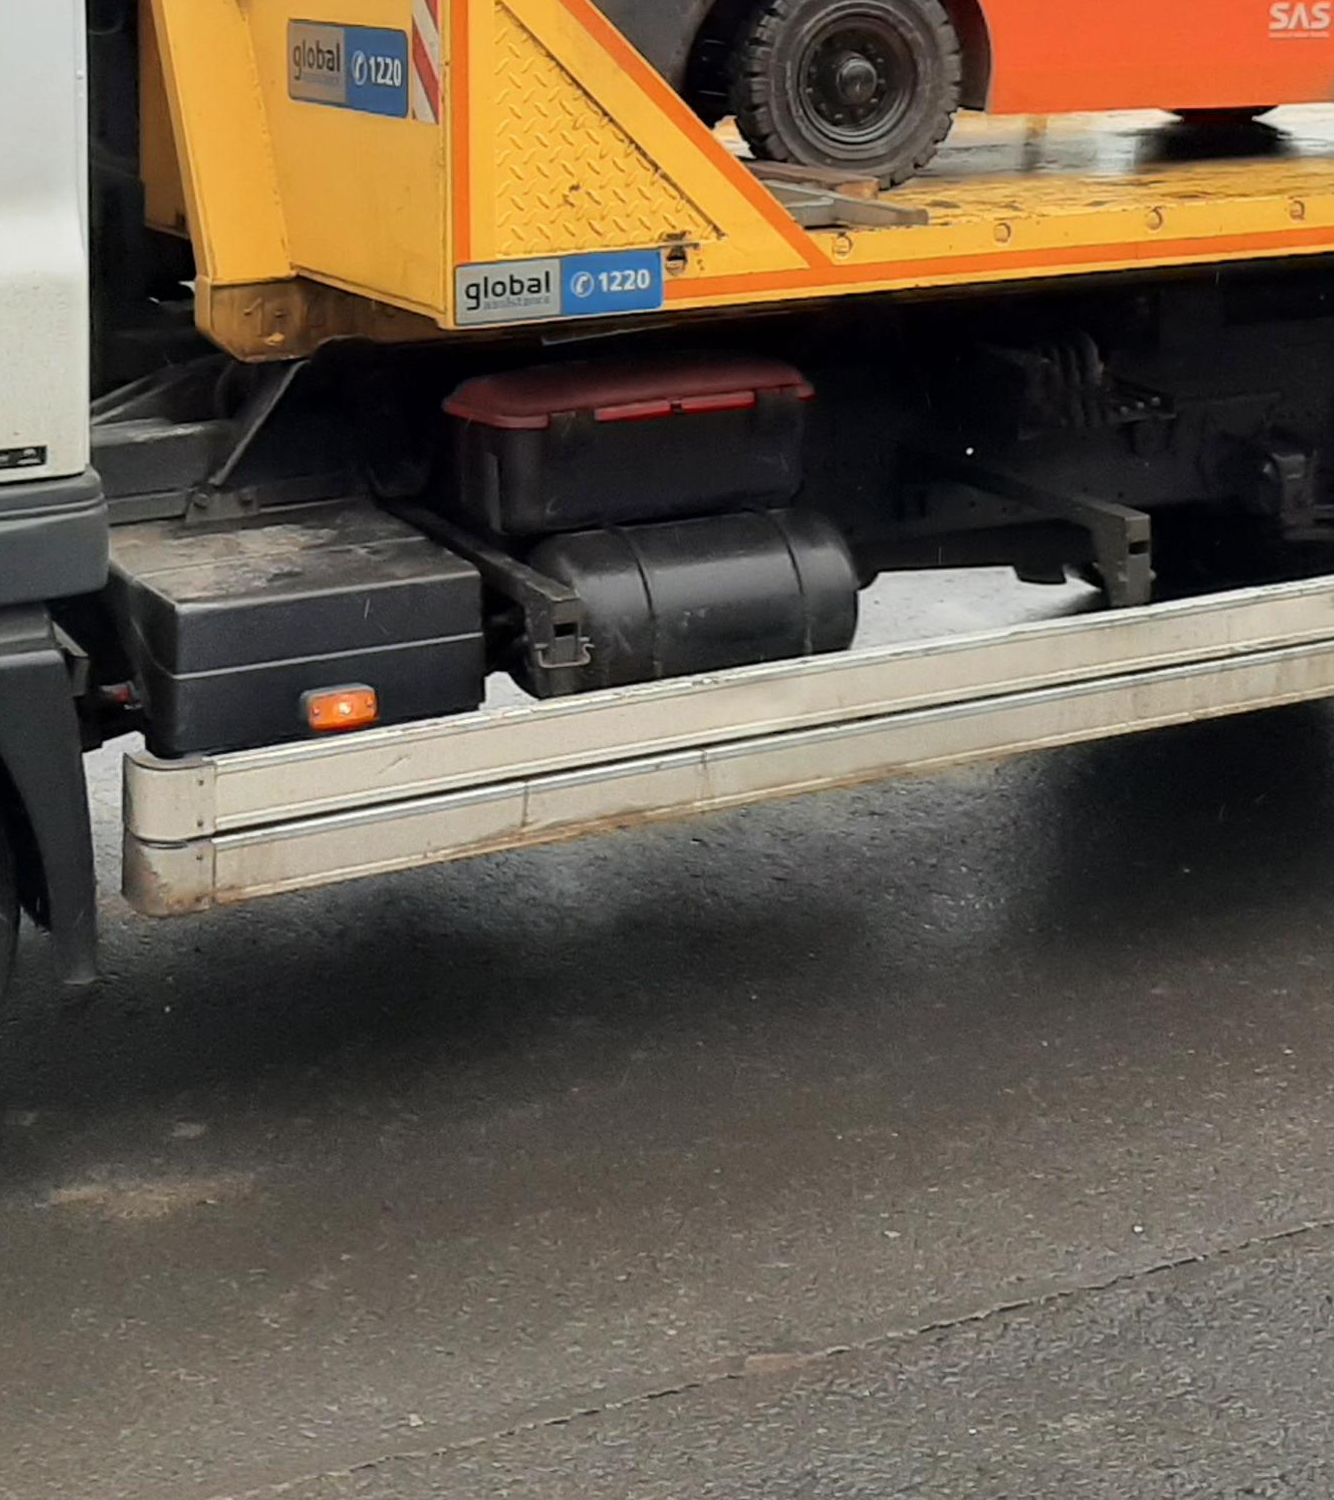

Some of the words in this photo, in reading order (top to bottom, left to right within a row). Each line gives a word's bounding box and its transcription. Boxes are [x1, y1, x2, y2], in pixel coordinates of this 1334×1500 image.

[1268, 1, 1332, 31] SAS
[292, 38, 341, 81] global
[368, 55, 403, 88] 1220
[464, 270, 551, 311] global
[598, 268, 651, 293] 1220
